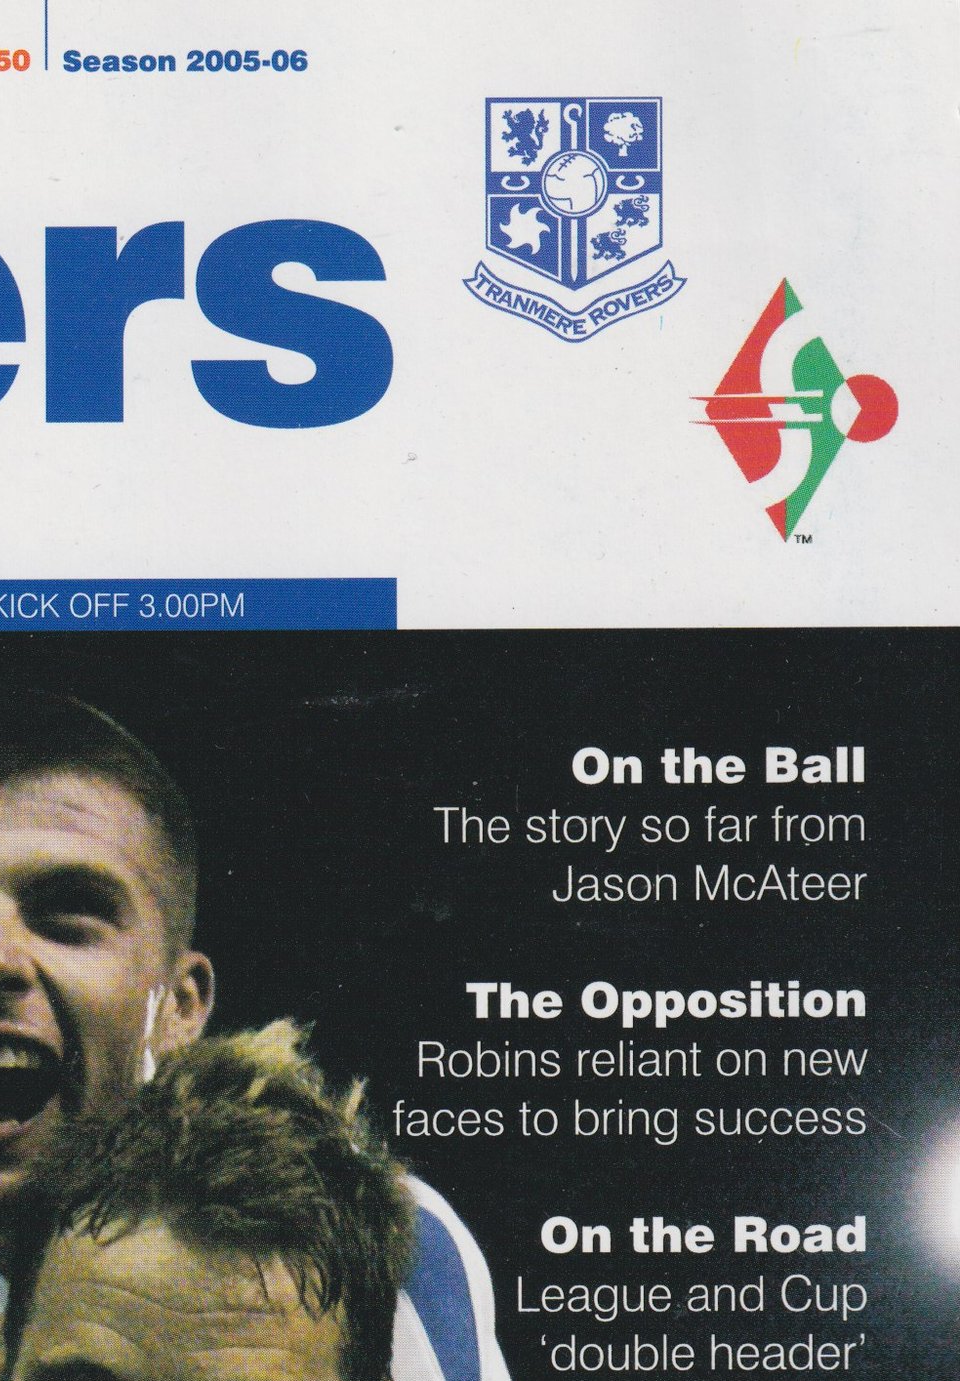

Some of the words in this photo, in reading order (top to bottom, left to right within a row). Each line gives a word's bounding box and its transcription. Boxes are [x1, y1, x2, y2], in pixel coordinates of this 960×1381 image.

[63, 51, 176, 73] Season
[187, 50, 308, 73] 2005-06
[475, 272, 587, 336] TRANMERE
[589, 273, 675, 327] ROVERS
[70, 593, 129, 618] OFF
[140, 593, 244, 618] 3.00PM
[572, 747, 642, 785] On
[661, 747, 746, 784] the
[766, 747, 864, 783] Ball
[434, 807, 510, 843] The
[527, 809, 626, 852] story
[642, 815, 689, 842] so
[705, 806, 757, 842] far
[772, 805, 866, 842] from
[553, 866, 676, 902] Jason
[696, 864, 867, 901] McAteer
[466, 983, 563, 1019] The
[581, 980, 865, 1028] Opposition
[419, 1041, 560, 1077] Robins
[578, 1040, 701, 1077] reliant
[717, 1049, 766, 1076] on
[784, 1049, 868, 1076] new
[393, 1100, 504, 1136] faces
[519, 1102, 558, 1136] to
[575, 1099, 677, 1145] bring
[696, 1108, 866, 1137] success
[541, 1216, 611, 1253] On
[629, 1217, 714, 1253] the
[735, 1215, 866, 1253] Road
[518, 1276, 671, 1322] League
[688, 1276, 763, 1312] and
[781, 1274, 867, 1321] Cup
